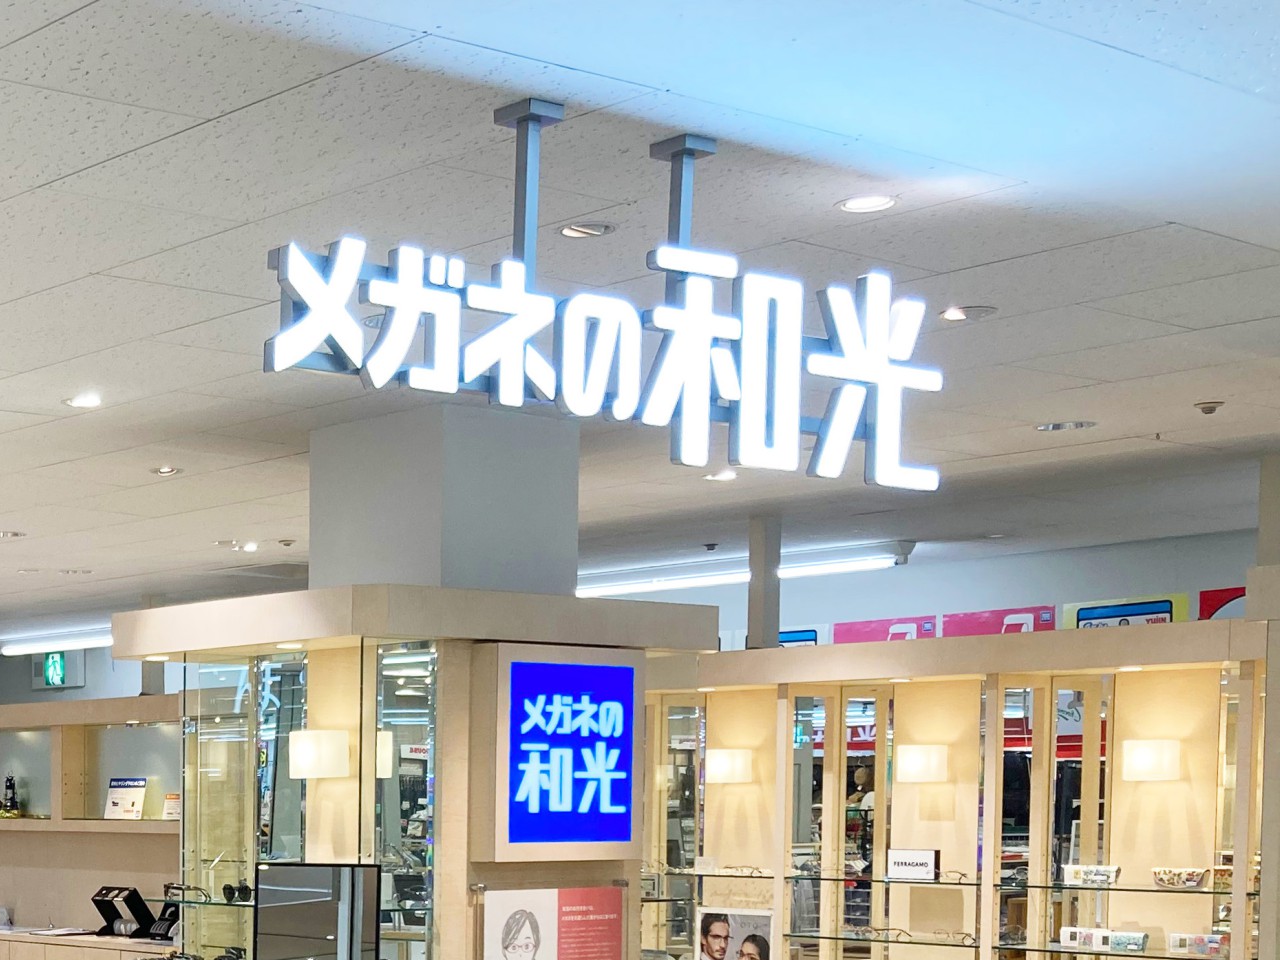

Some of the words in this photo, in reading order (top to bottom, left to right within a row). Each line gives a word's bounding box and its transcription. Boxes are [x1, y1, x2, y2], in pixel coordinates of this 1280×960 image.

[270, 236, 944, 492] メガネの和光
[521, 694, 624, 738] メガネの
[514, 741, 627, 814] 和光
